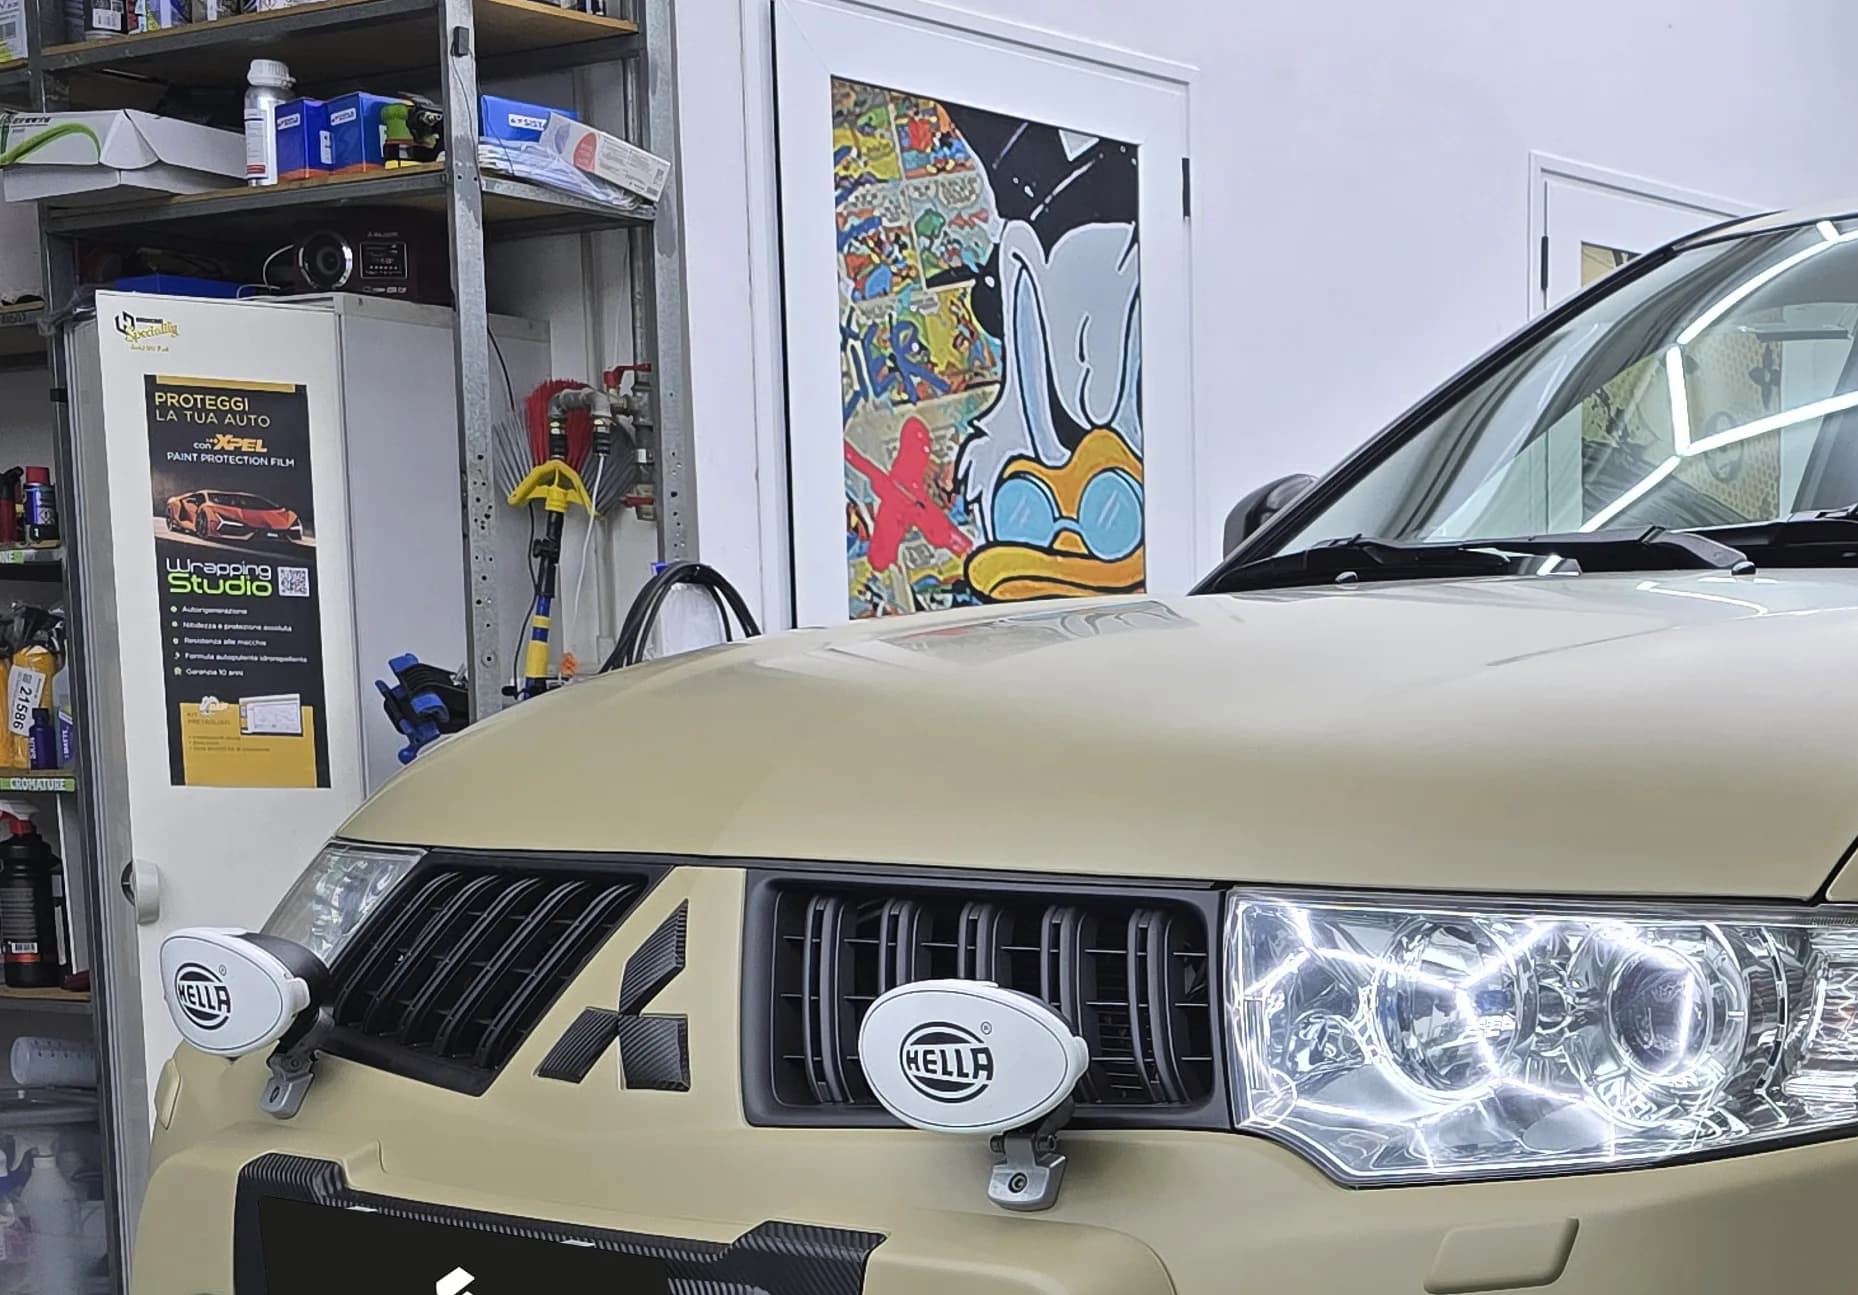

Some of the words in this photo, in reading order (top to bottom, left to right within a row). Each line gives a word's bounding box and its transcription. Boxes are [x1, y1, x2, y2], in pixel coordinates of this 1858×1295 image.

[155, 392, 249, 411] PROTEGGI
[156, 409, 178, 422] LA
[184, 411, 218, 425] TUA
[224, 414, 271, 428] AUTO
[193, 441, 212, 450] con
[213, 433, 268, 453] XPEL
[167, 452, 199, 462] PAINT
[201, 453, 269, 466] PROTECTION
[270, 457, 295, 468] FILM
[166, 557, 272, 581] Wrapping
[168, 573, 273, 597] Studio
[13, 685, 32, 730] 21586
[10, 778, 65, 791] CROMATURE
[178, 983, 231, 1014] HELLA
[906, 1046, 994, 1081] HELLA
